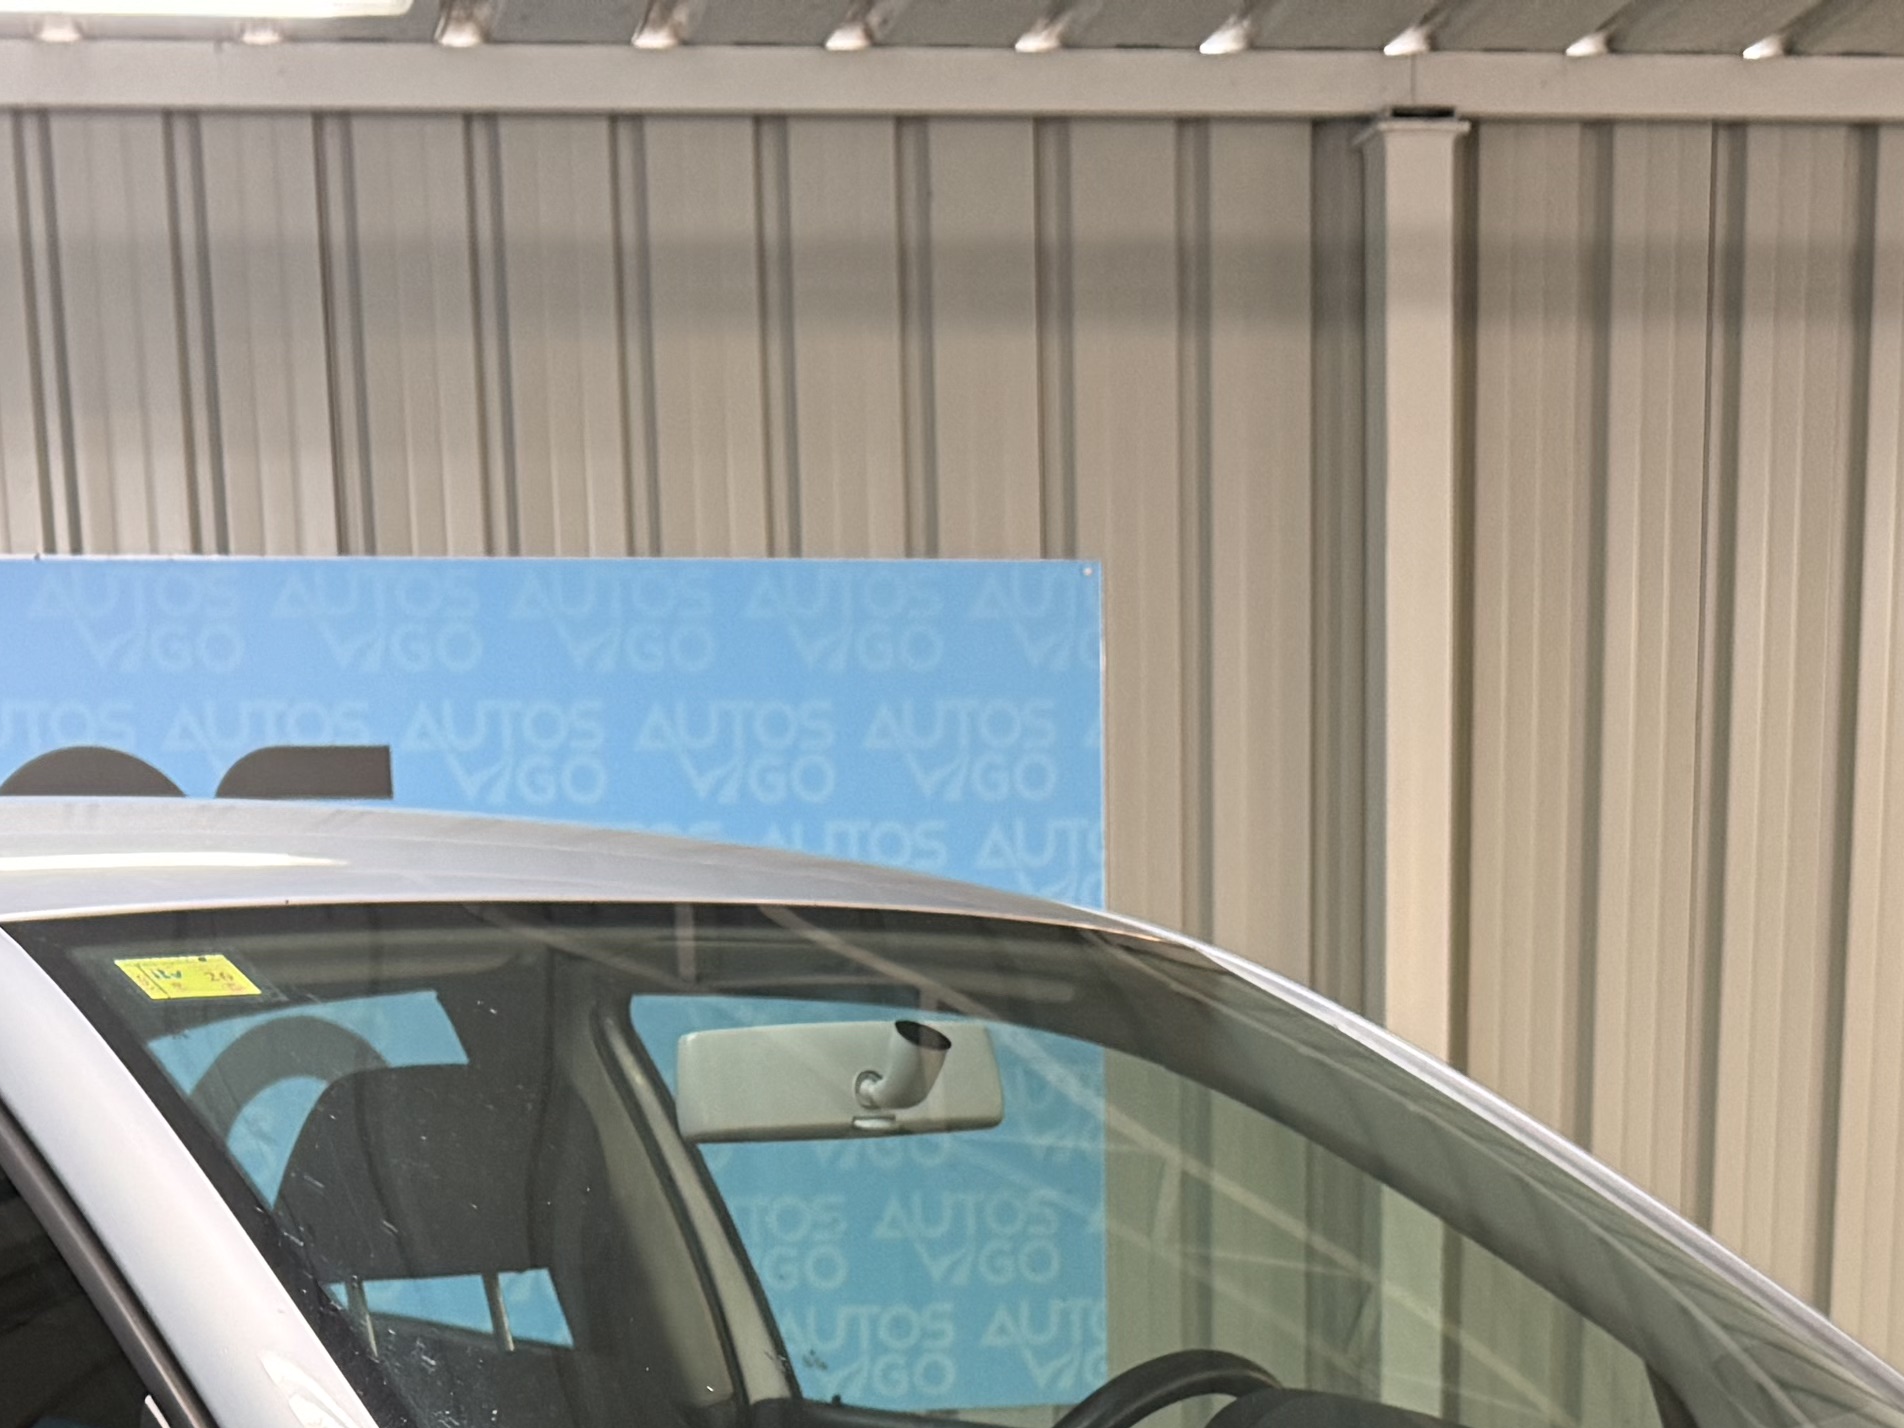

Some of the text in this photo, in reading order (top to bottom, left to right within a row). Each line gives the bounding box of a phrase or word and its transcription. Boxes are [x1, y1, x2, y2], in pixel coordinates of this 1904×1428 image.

[28, 567, 241, 618] AUTOS
[271, 567, 480, 618] AUTOS
[508, 567, 713, 618] AUTOS
[745, 567, 943, 618] AUTOS
[968, 568, 1099, 617] AUT
[76, 622, 244, 674] VIGO
[318, 622, 484, 674] VIGO
[555, 622, 717, 673] VIGO
[787, 622, 944, 673] VIGO
[400, 700, 604, 750] AUTOS
[636, 700, 834, 750] AUTOS
[864, 700, 1056, 750] AUTOS
[446, 753, 608, 801] VIGO
[681, 753, 837, 802] VIGO
[904, 753, 1056, 801] VIGO
[872, 1191, 1059, 1239] AUTOS
[912, 1240, 1060, 1286] VIGO
